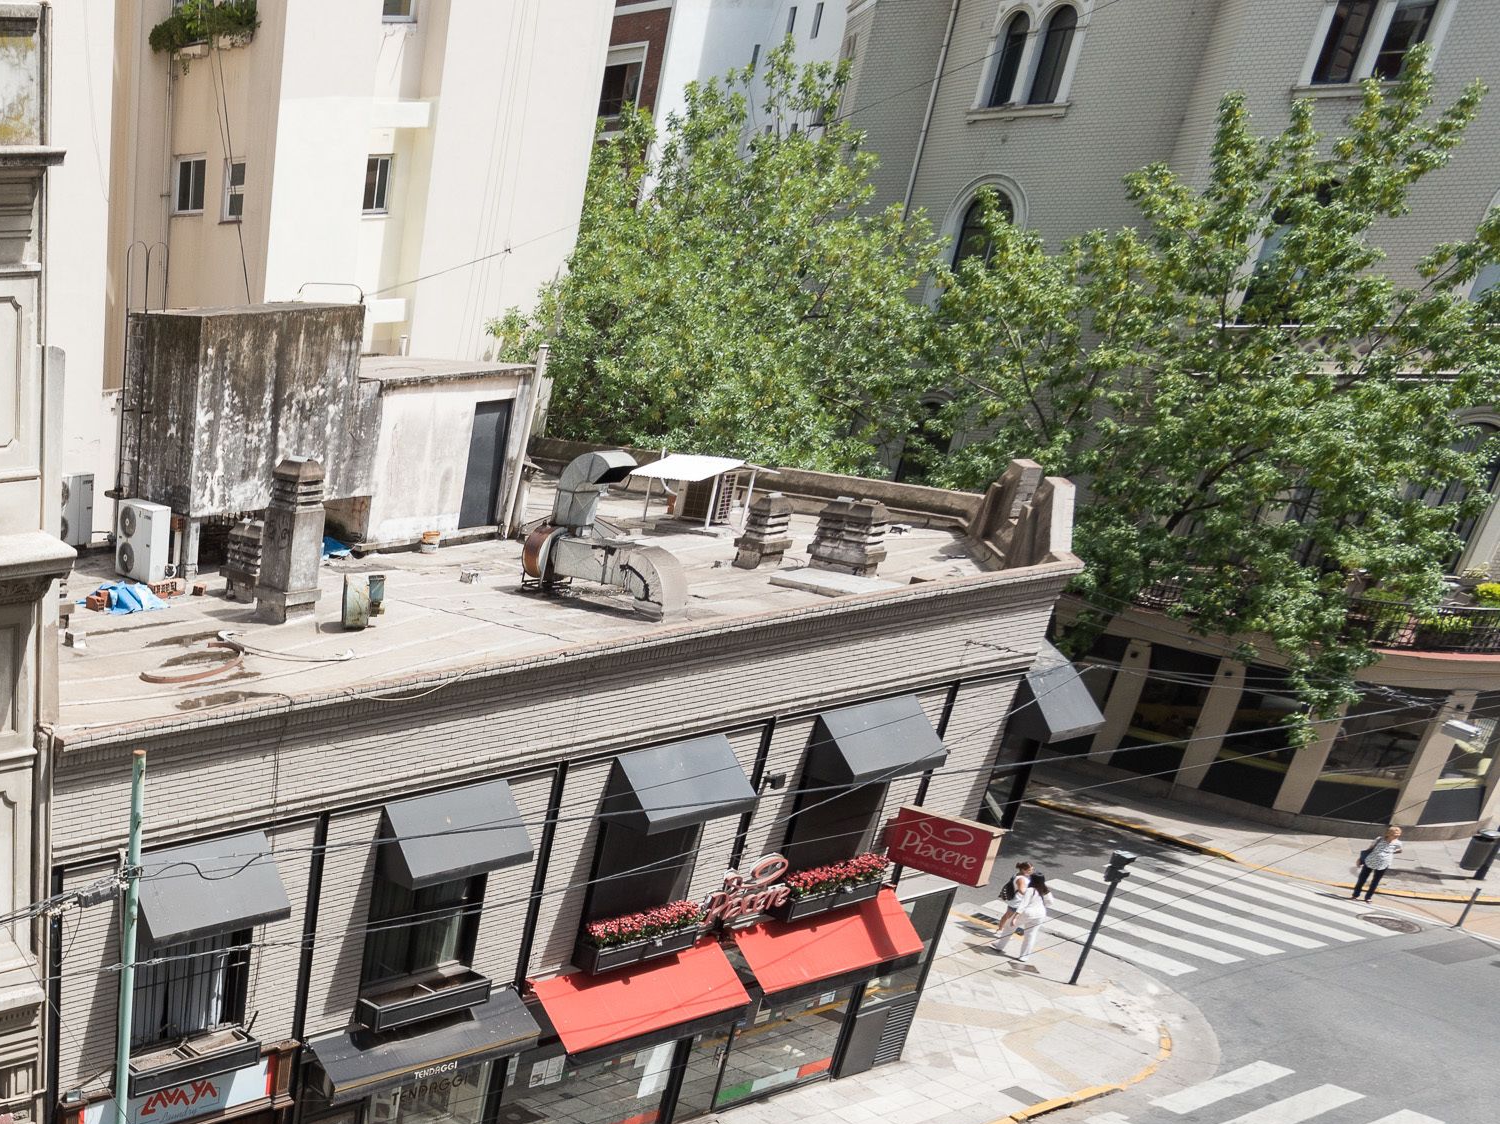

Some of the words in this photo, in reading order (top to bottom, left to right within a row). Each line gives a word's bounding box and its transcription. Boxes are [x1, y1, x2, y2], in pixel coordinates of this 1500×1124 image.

[898, 829, 977, 870] Piacere
[414, 1060, 458, 1079] TENDAGGI
[391, 1073, 468, 1106] TENDAGGI
